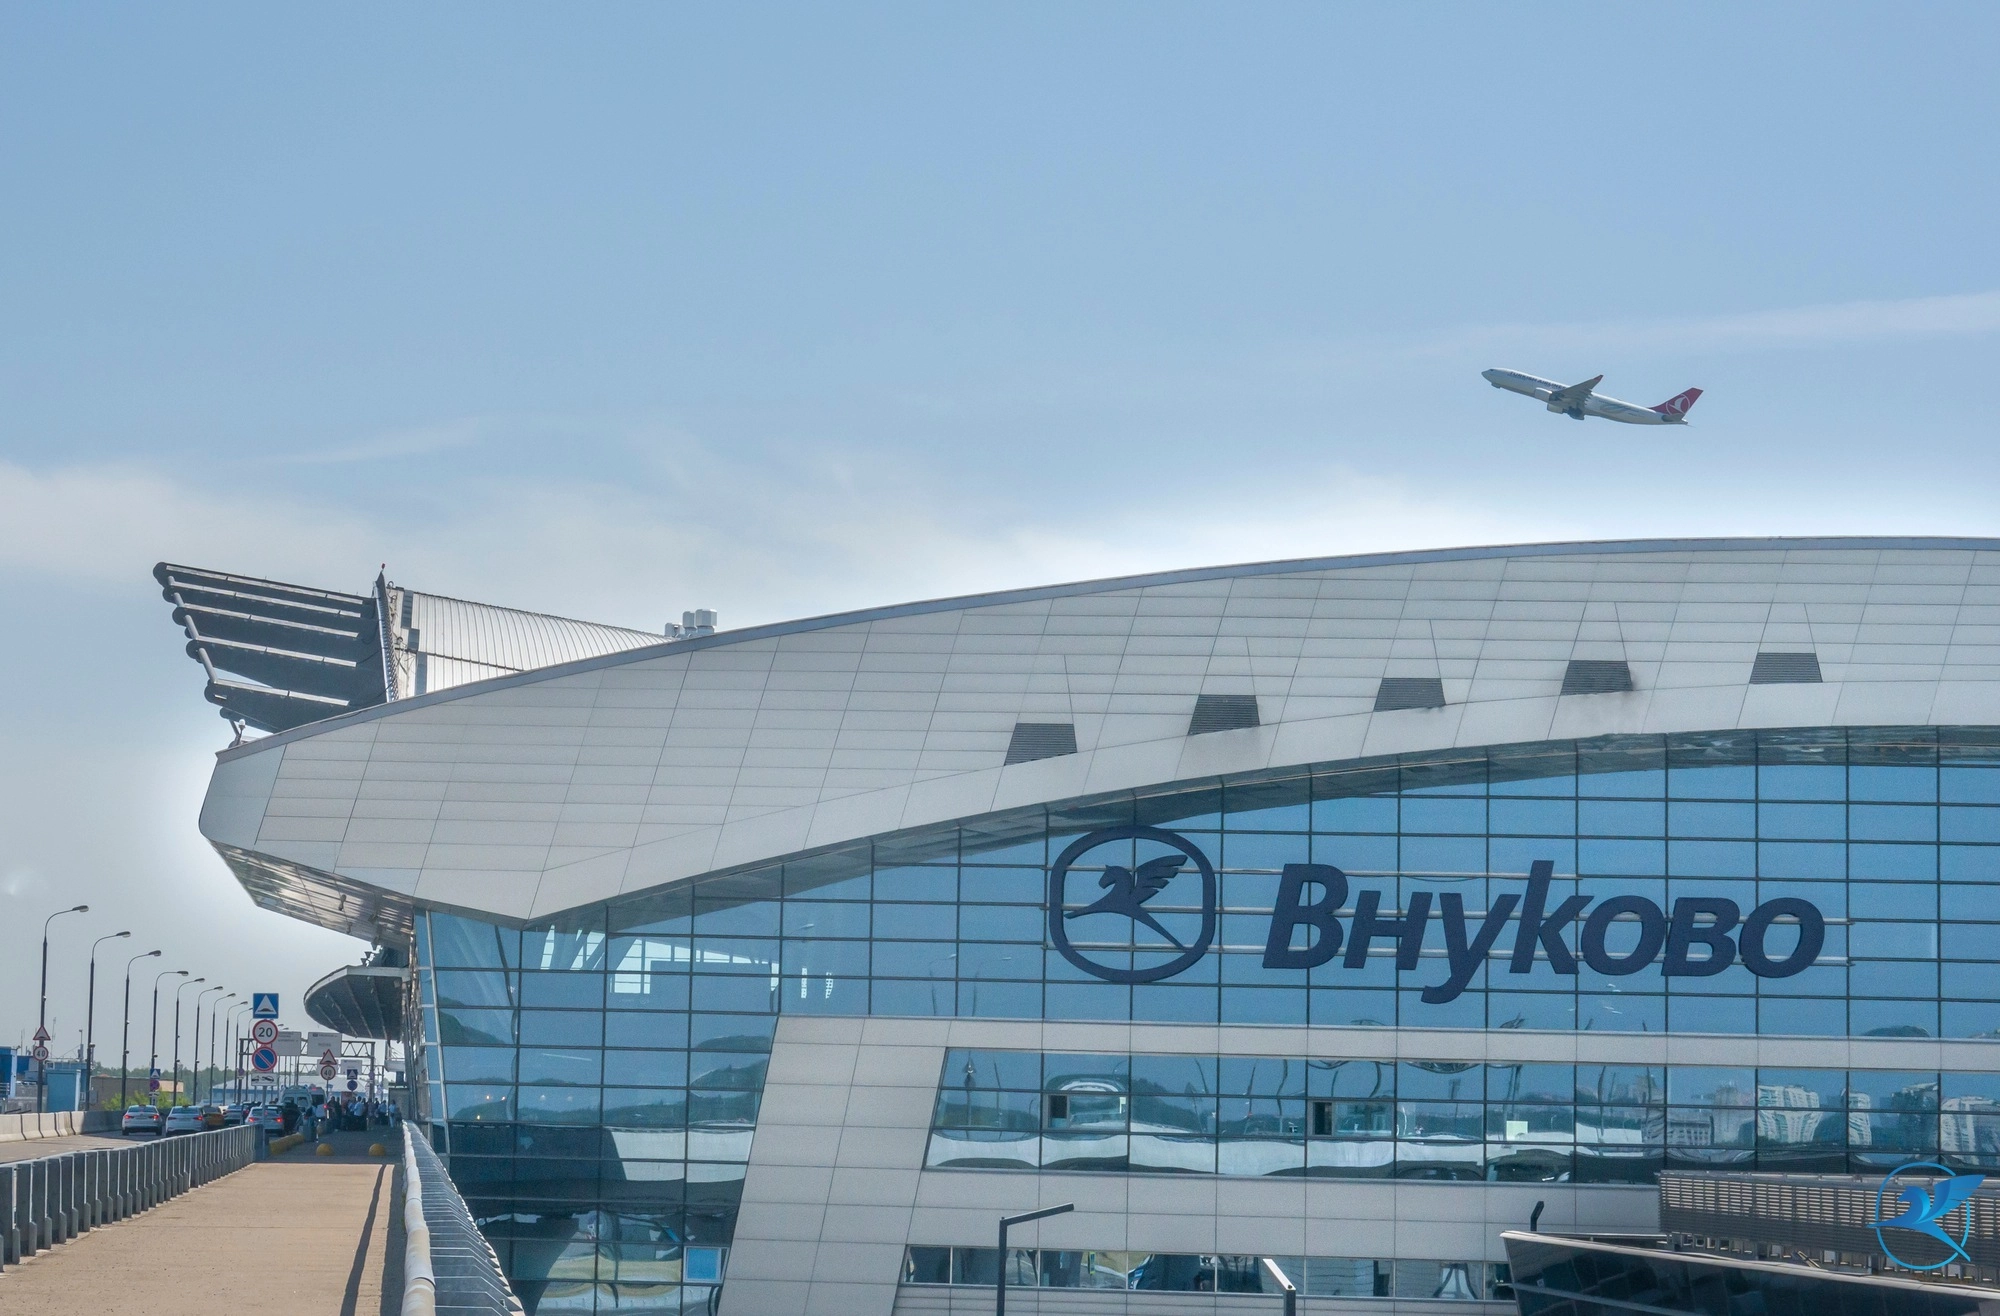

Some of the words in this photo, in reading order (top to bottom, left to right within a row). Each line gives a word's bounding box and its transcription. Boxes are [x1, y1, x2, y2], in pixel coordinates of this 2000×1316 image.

[1262, 860, 1825, 1004] Внуково
[257, 1027, 273, 1038] 20
[36, 1050, 46, 1058] 40
[323, 1069, 333, 1077] 40
